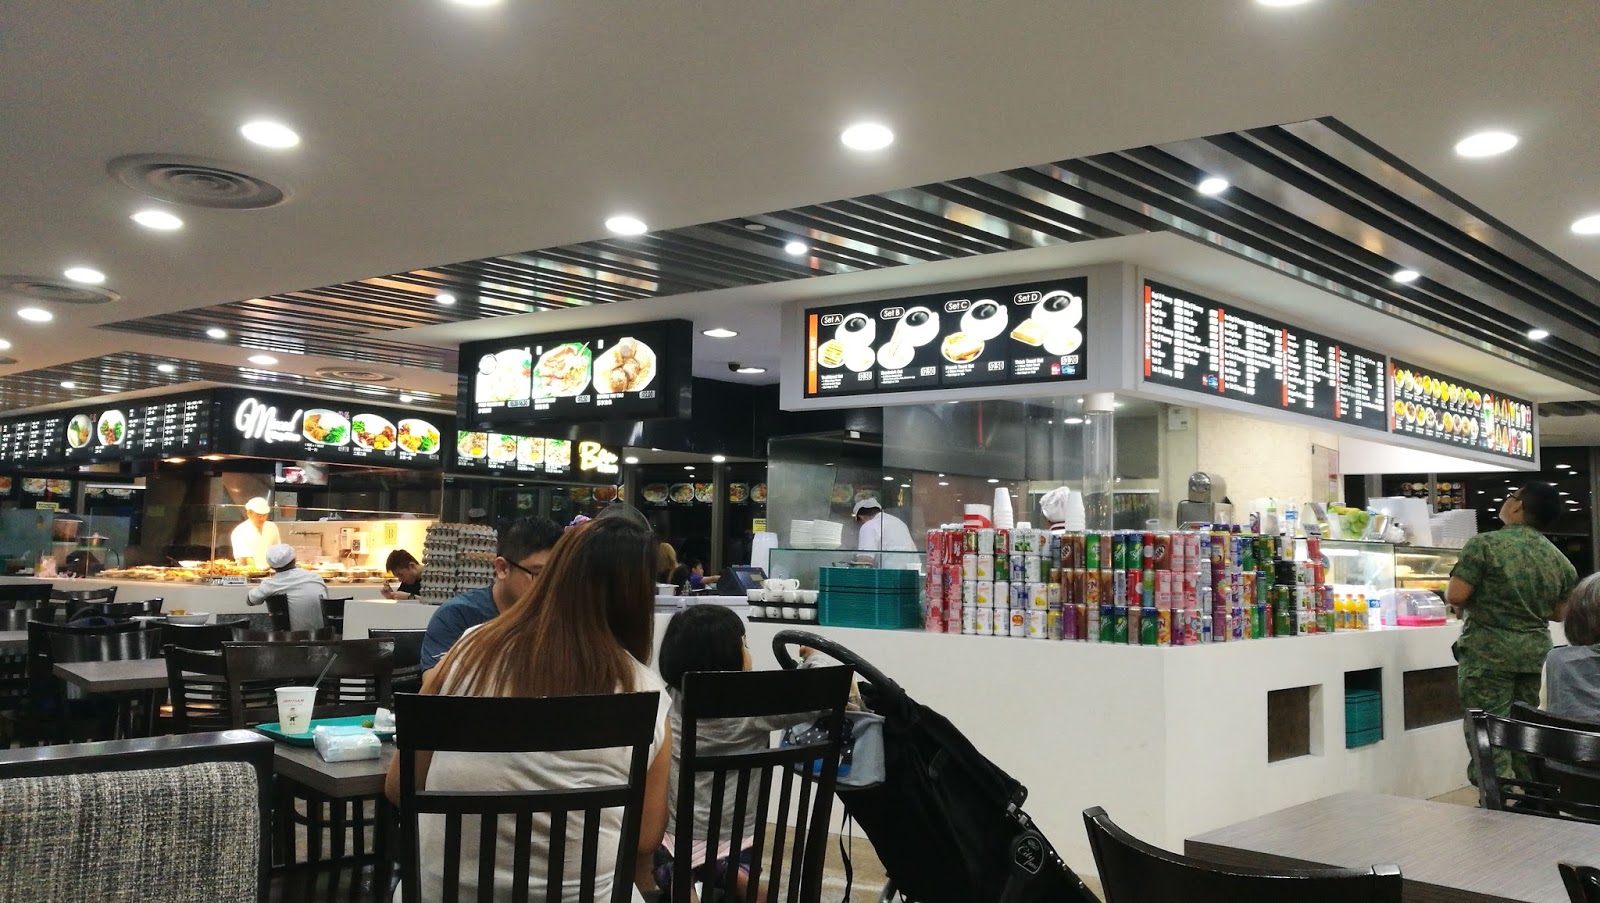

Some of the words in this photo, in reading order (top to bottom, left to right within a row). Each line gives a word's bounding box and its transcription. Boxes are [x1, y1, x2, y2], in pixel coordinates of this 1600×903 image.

[1018, 294, 1030, 303] Set
[948, 302, 960, 310] Set
[960, 301, 968, 309] C
[883, 310, 894, 318] Set
